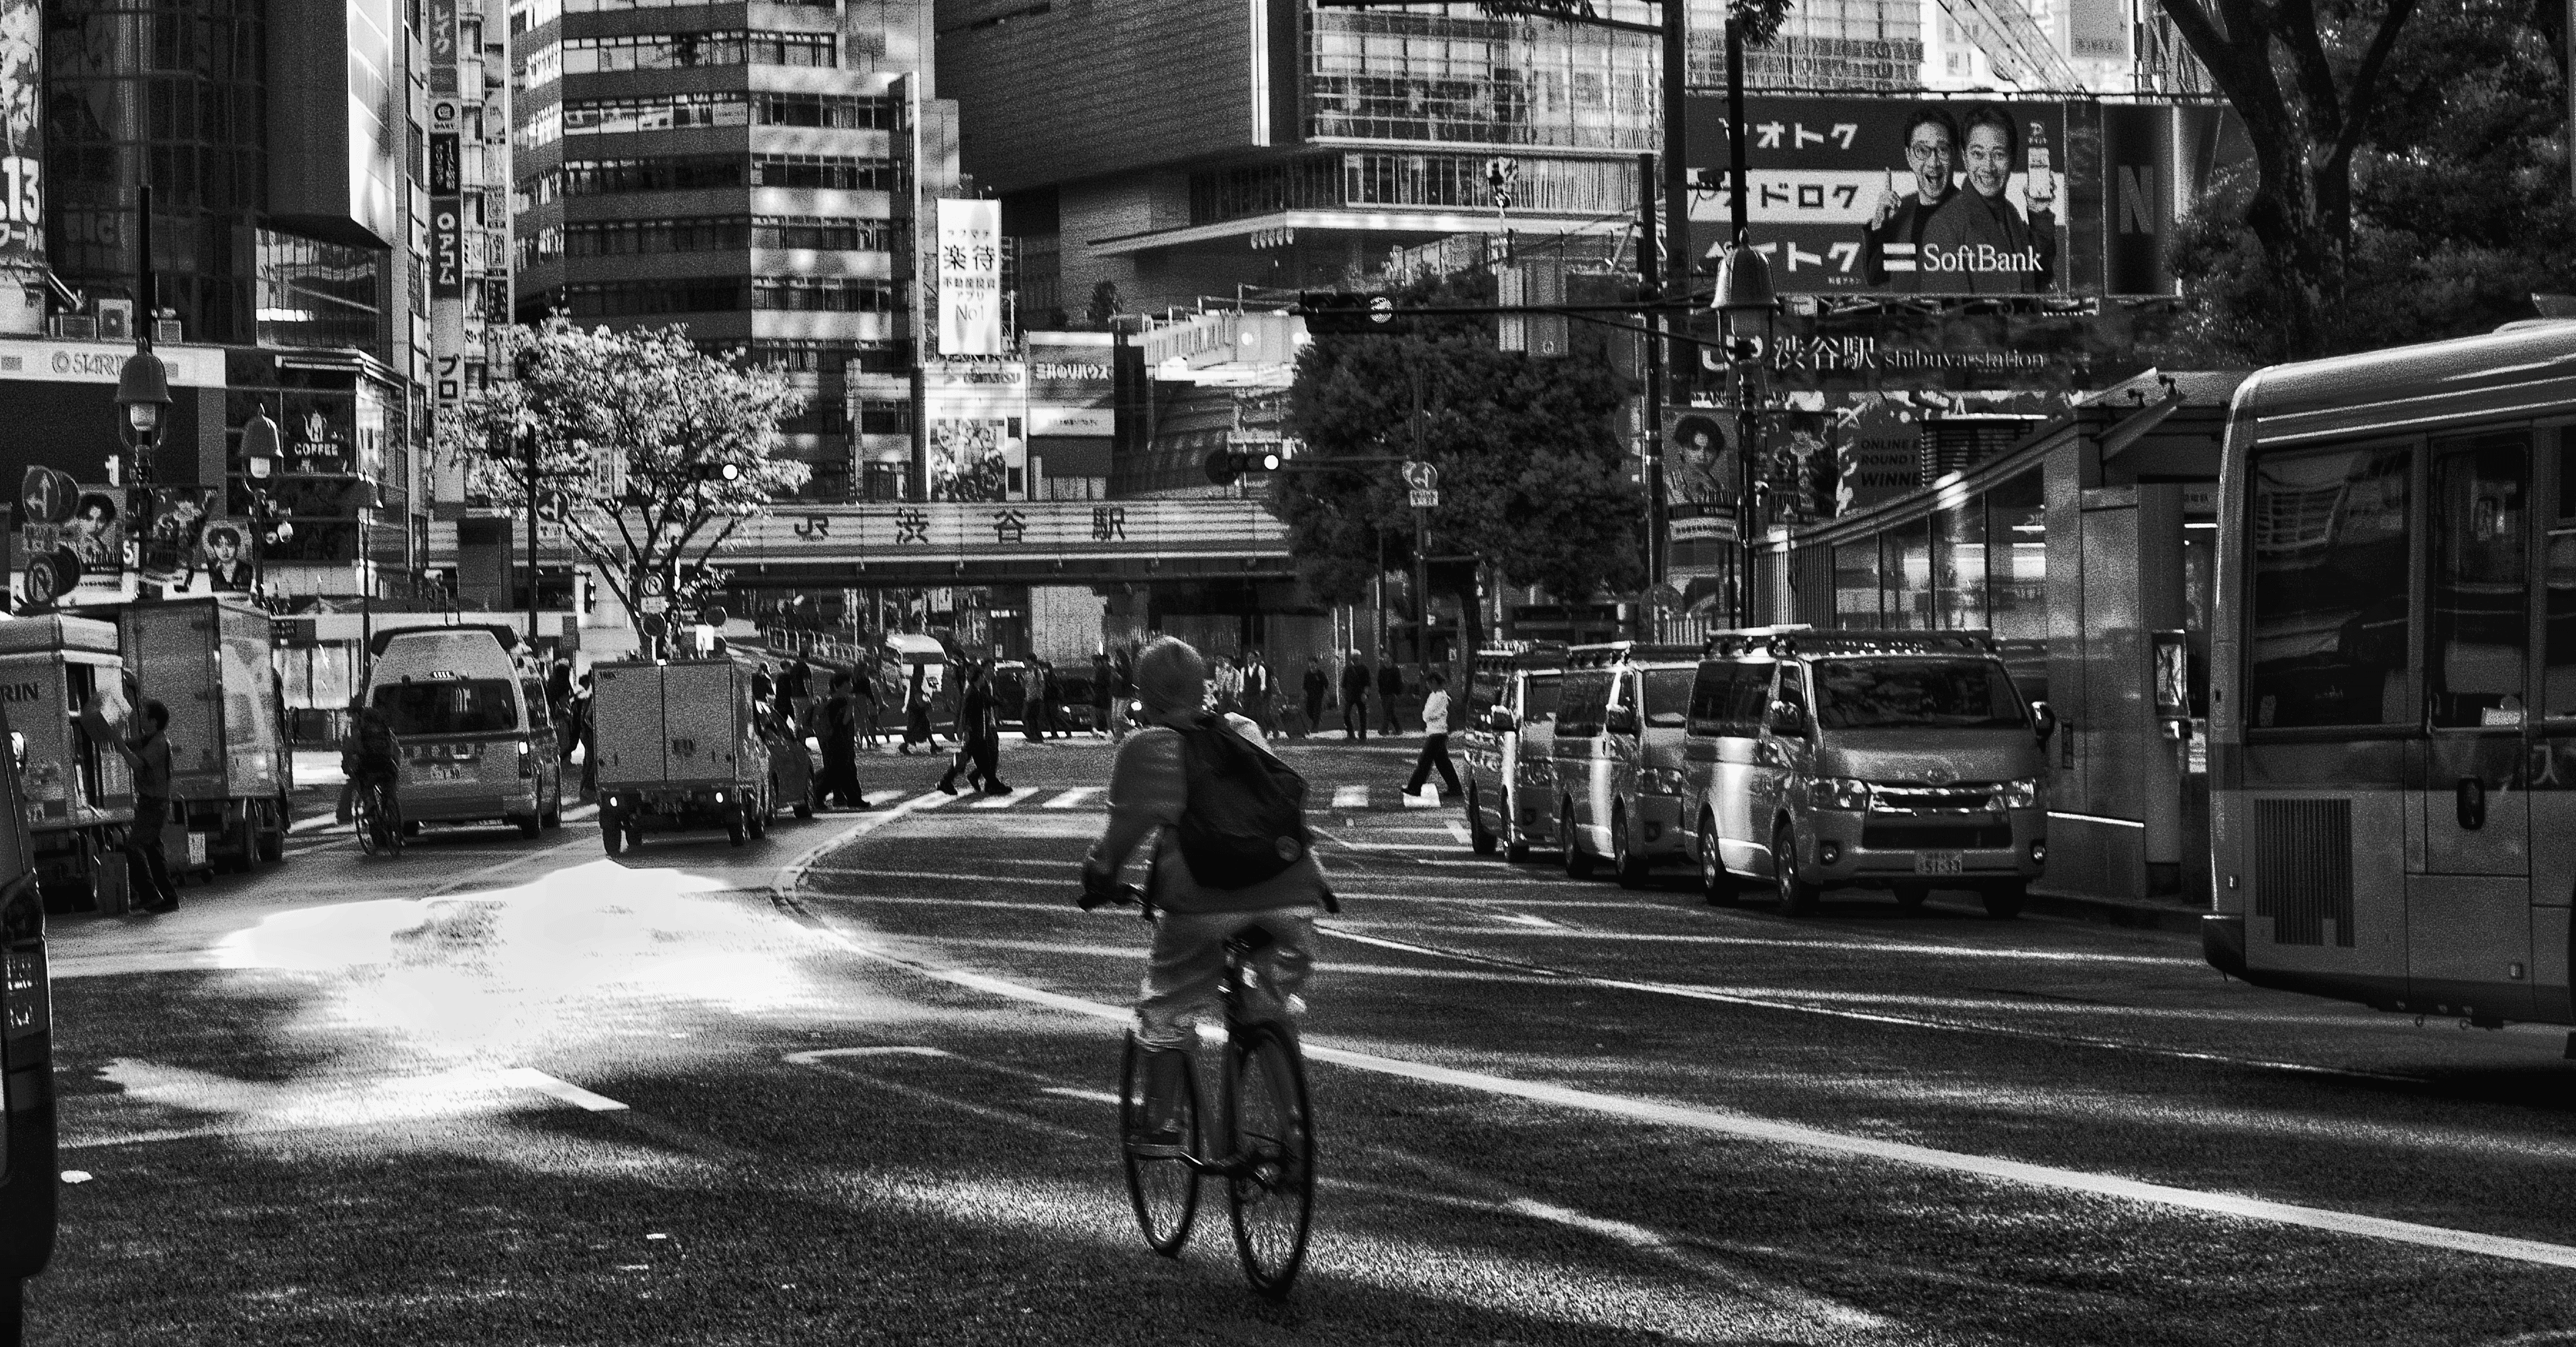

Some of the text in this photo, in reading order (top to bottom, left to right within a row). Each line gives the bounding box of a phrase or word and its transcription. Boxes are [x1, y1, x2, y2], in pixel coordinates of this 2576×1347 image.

[1719, 117, 1858, 150] オトク
[1723, 182, 1859, 209] ドロク
[2118, 166, 2154, 234] N
[943, 245, 996, 272] 楽待
[1923, 243, 2044, 272] SoftBank
[1774, 335, 1874, 370] 渋谷駅
[1886, 349, 1968, 369] shibuya
[294, 443, 339, 456] COFFEE
[1861, 438, 1909, 449] ONLINE
[1861, 454, 1907, 465] ROUND
[794, 507, 1126, 545] JR 渋谷駅
